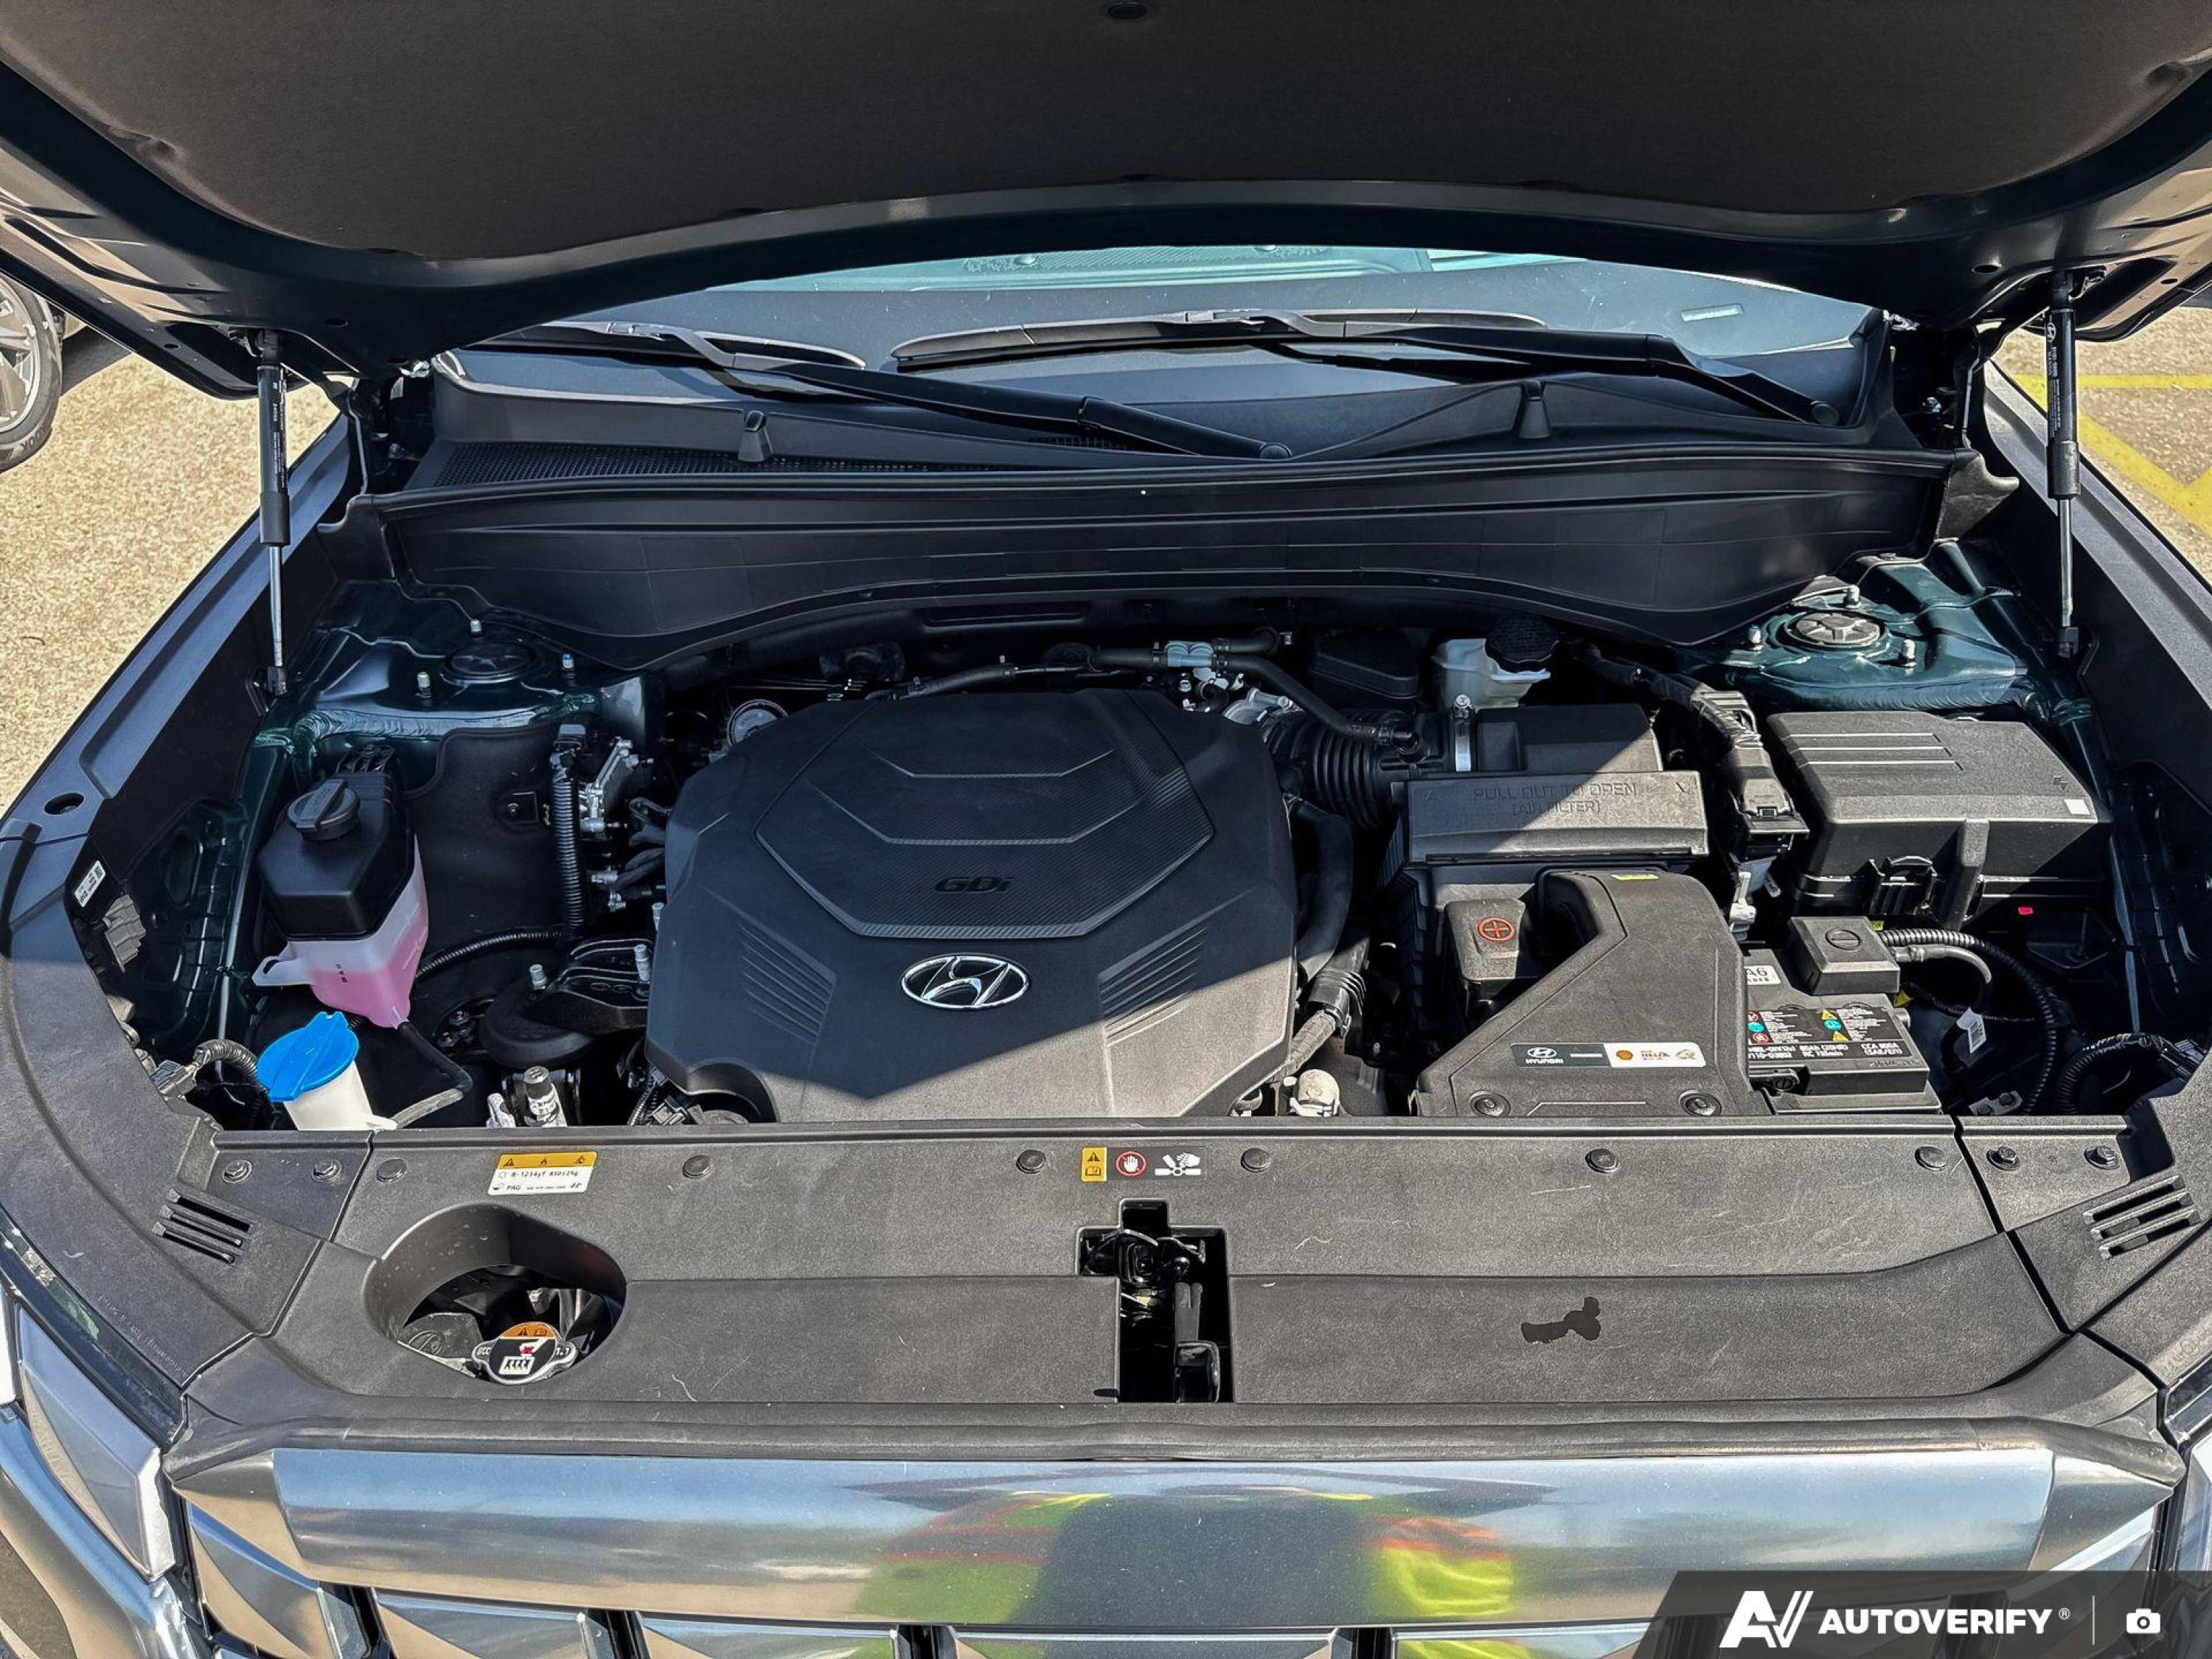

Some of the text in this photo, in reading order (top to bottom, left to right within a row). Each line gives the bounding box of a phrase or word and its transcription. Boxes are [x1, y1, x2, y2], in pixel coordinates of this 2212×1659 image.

[1475, 782, 1637, 799] PULL OUT TO OPEN
